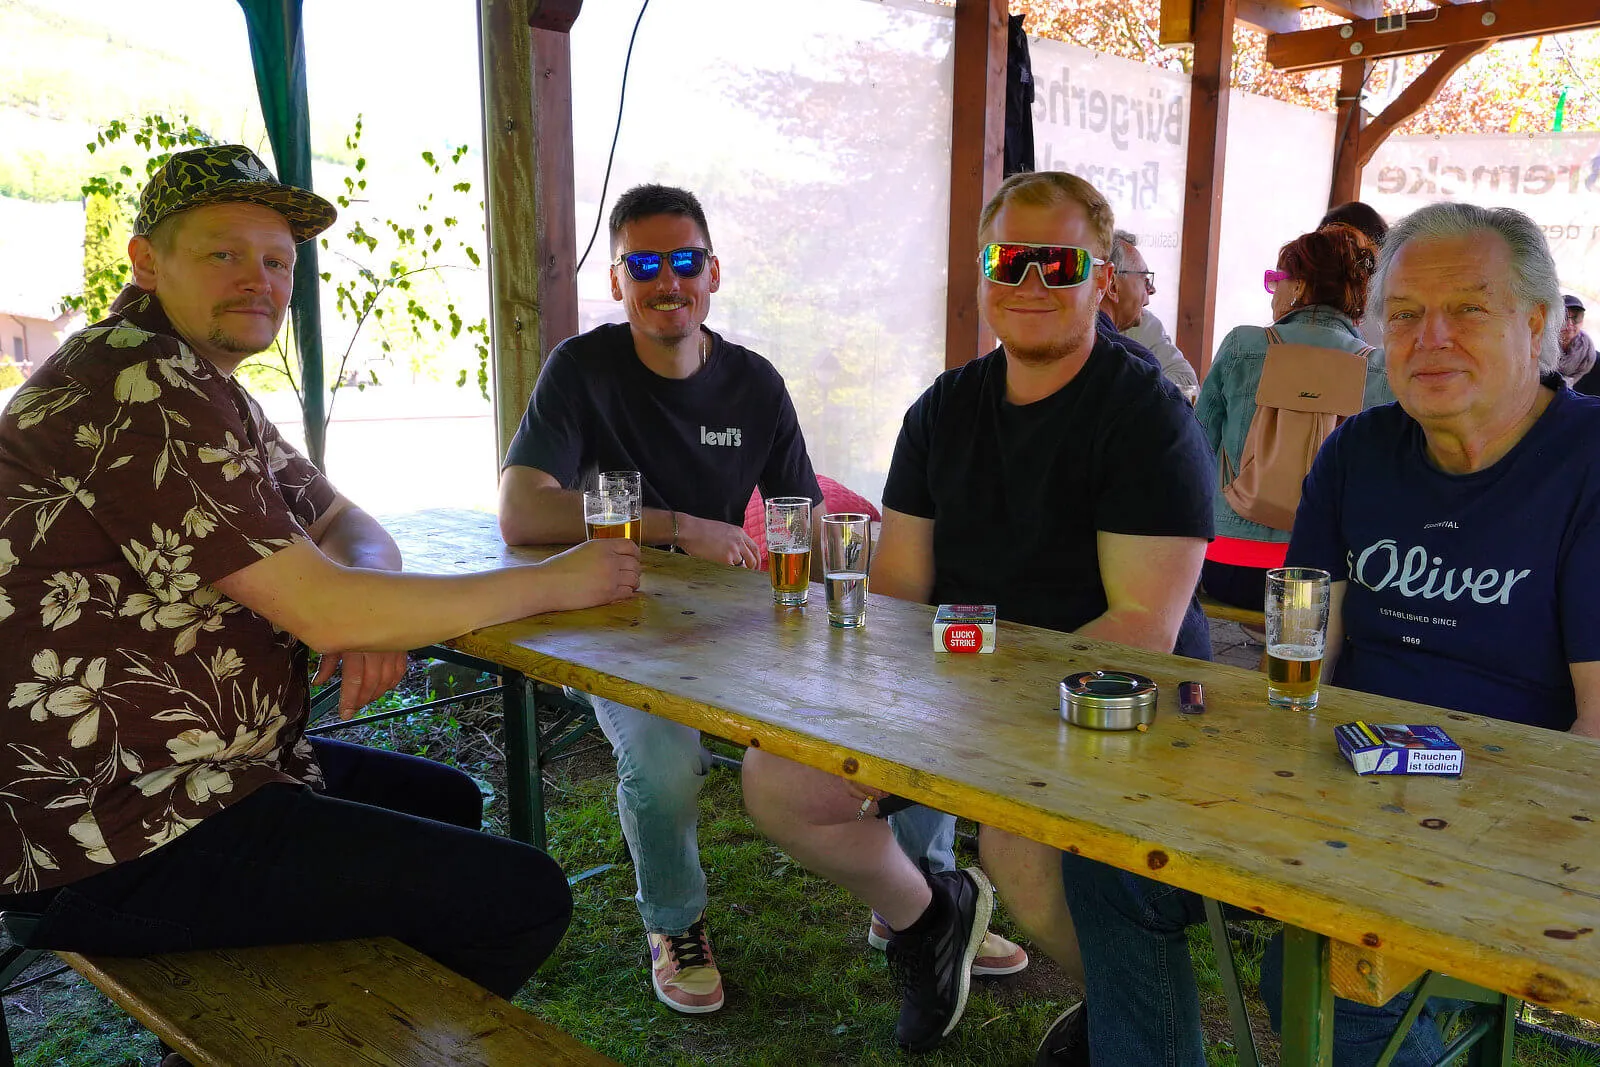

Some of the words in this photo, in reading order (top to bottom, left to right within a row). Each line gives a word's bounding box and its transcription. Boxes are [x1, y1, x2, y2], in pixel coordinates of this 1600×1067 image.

[1379, 607, 1430, 623] ESTABLISHED
[1432, 617, 1457, 627] SINCE
[951, 630, 976, 639] LUCKY
[950, 639, 976, 647] STRIKE
[1402, 635, 1421, 645] 1969
[1413, 752, 1457, 761] Rauchen
[1409, 763, 1421, 771] ist
[1424, 762, 1459, 771] tödlich
